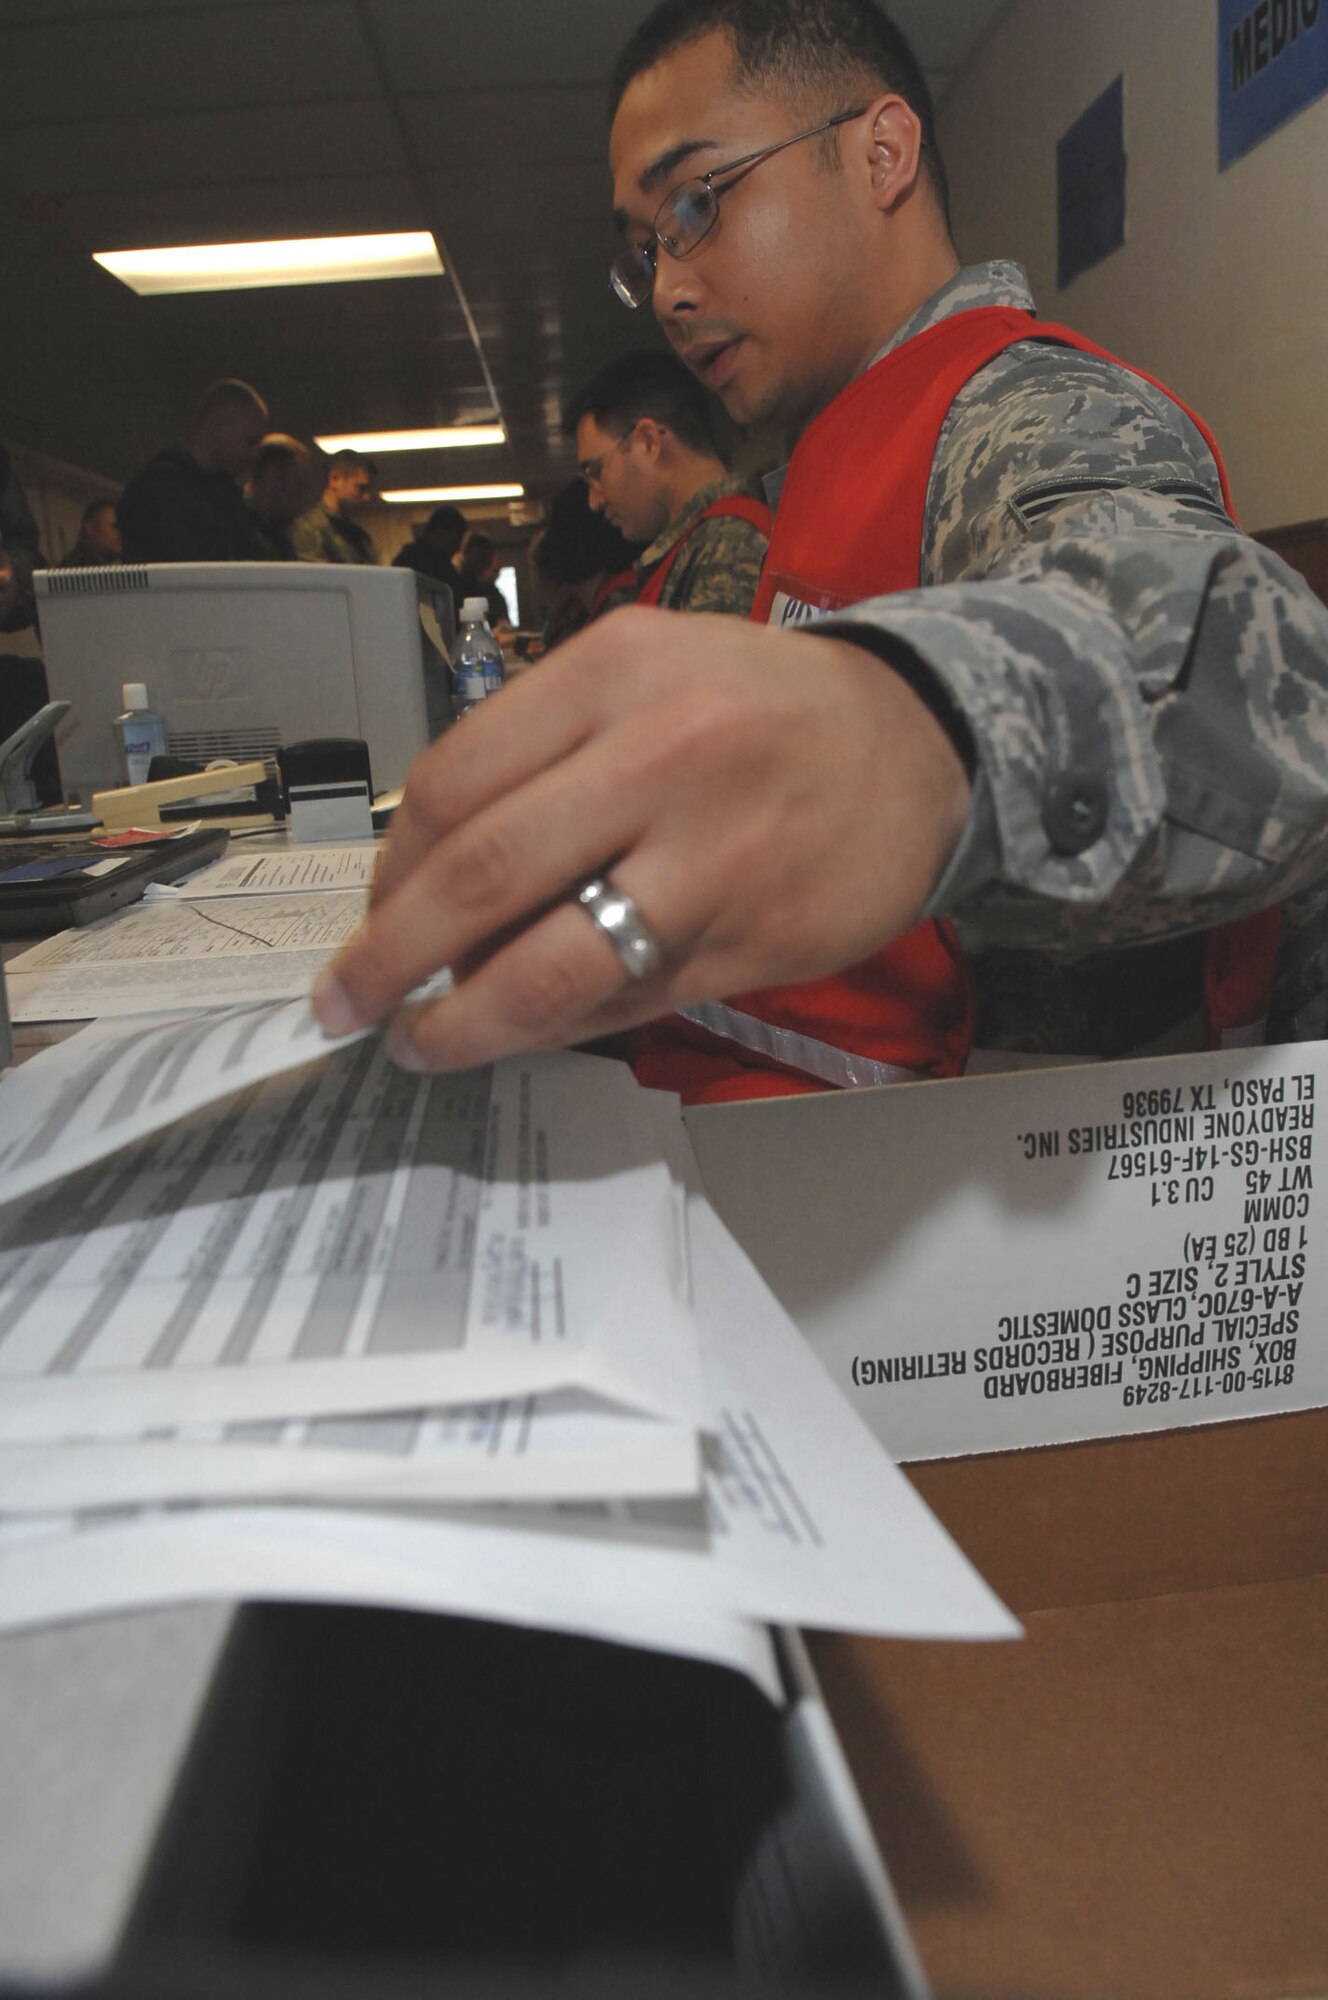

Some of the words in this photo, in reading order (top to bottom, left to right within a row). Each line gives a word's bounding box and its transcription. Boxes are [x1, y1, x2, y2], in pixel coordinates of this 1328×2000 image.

[1123, 1087, 1184, 1118] 79936
[1190, 1084, 1216, 1111] TX
[1224, 1077, 1285, 1107] PASO,
[1292, 1074, 1315, 1101] EL
[1068, 1116, 1194, 1155] INDUSTRIES
[1204, 1103, 1314, 1139] READYONE
[1017, 1131, 1059, 1159] INC.
[1107, 1134, 1312, 1180] BSH-GS-14F-61567
[1151, 1180, 1179, 1207] 3.1
[1185, 1176, 1214, 1203] CU
[1245, 1169, 1272, 1195] 45
[1278, 1165, 1313, 1192] WT
[1244, 1193, 1310, 1224] COMM
[1183, 1232, 1217, 1263] EA)
[1224, 1225, 1256, 1257] (25
[1263, 1226, 1290, 1253] BD
[1299, 1225, 1307, 1249] 1
[1148, 1266, 1198, 1297] SIZE
[1207, 1260, 1228, 1288] 2,
[1234, 1253, 1306, 1286] STYLE
[1126, 1273, 1141, 1299] C
[1191, 1282, 1304, 1318] A-A-670C,
[998, 1305, 1111, 1342] DOMESTIC
[1118, 1296, 1187, 1327] CLASS
[1212, 1309, 1299, 1343] SPECIAL
[1101, 1322, 1205, 1357] PURPOSE
[1249, 1338, 1297, 1365] BOX,
[851, 1351, 966, 1386] RETIRING)
[1131, 1346, 1241, 1381] SHIPPING,
[983, 1361, 1123, 1399] FIBERBOARD
[1123, 1364, 1294, 1407] 8115-00-117-8249
